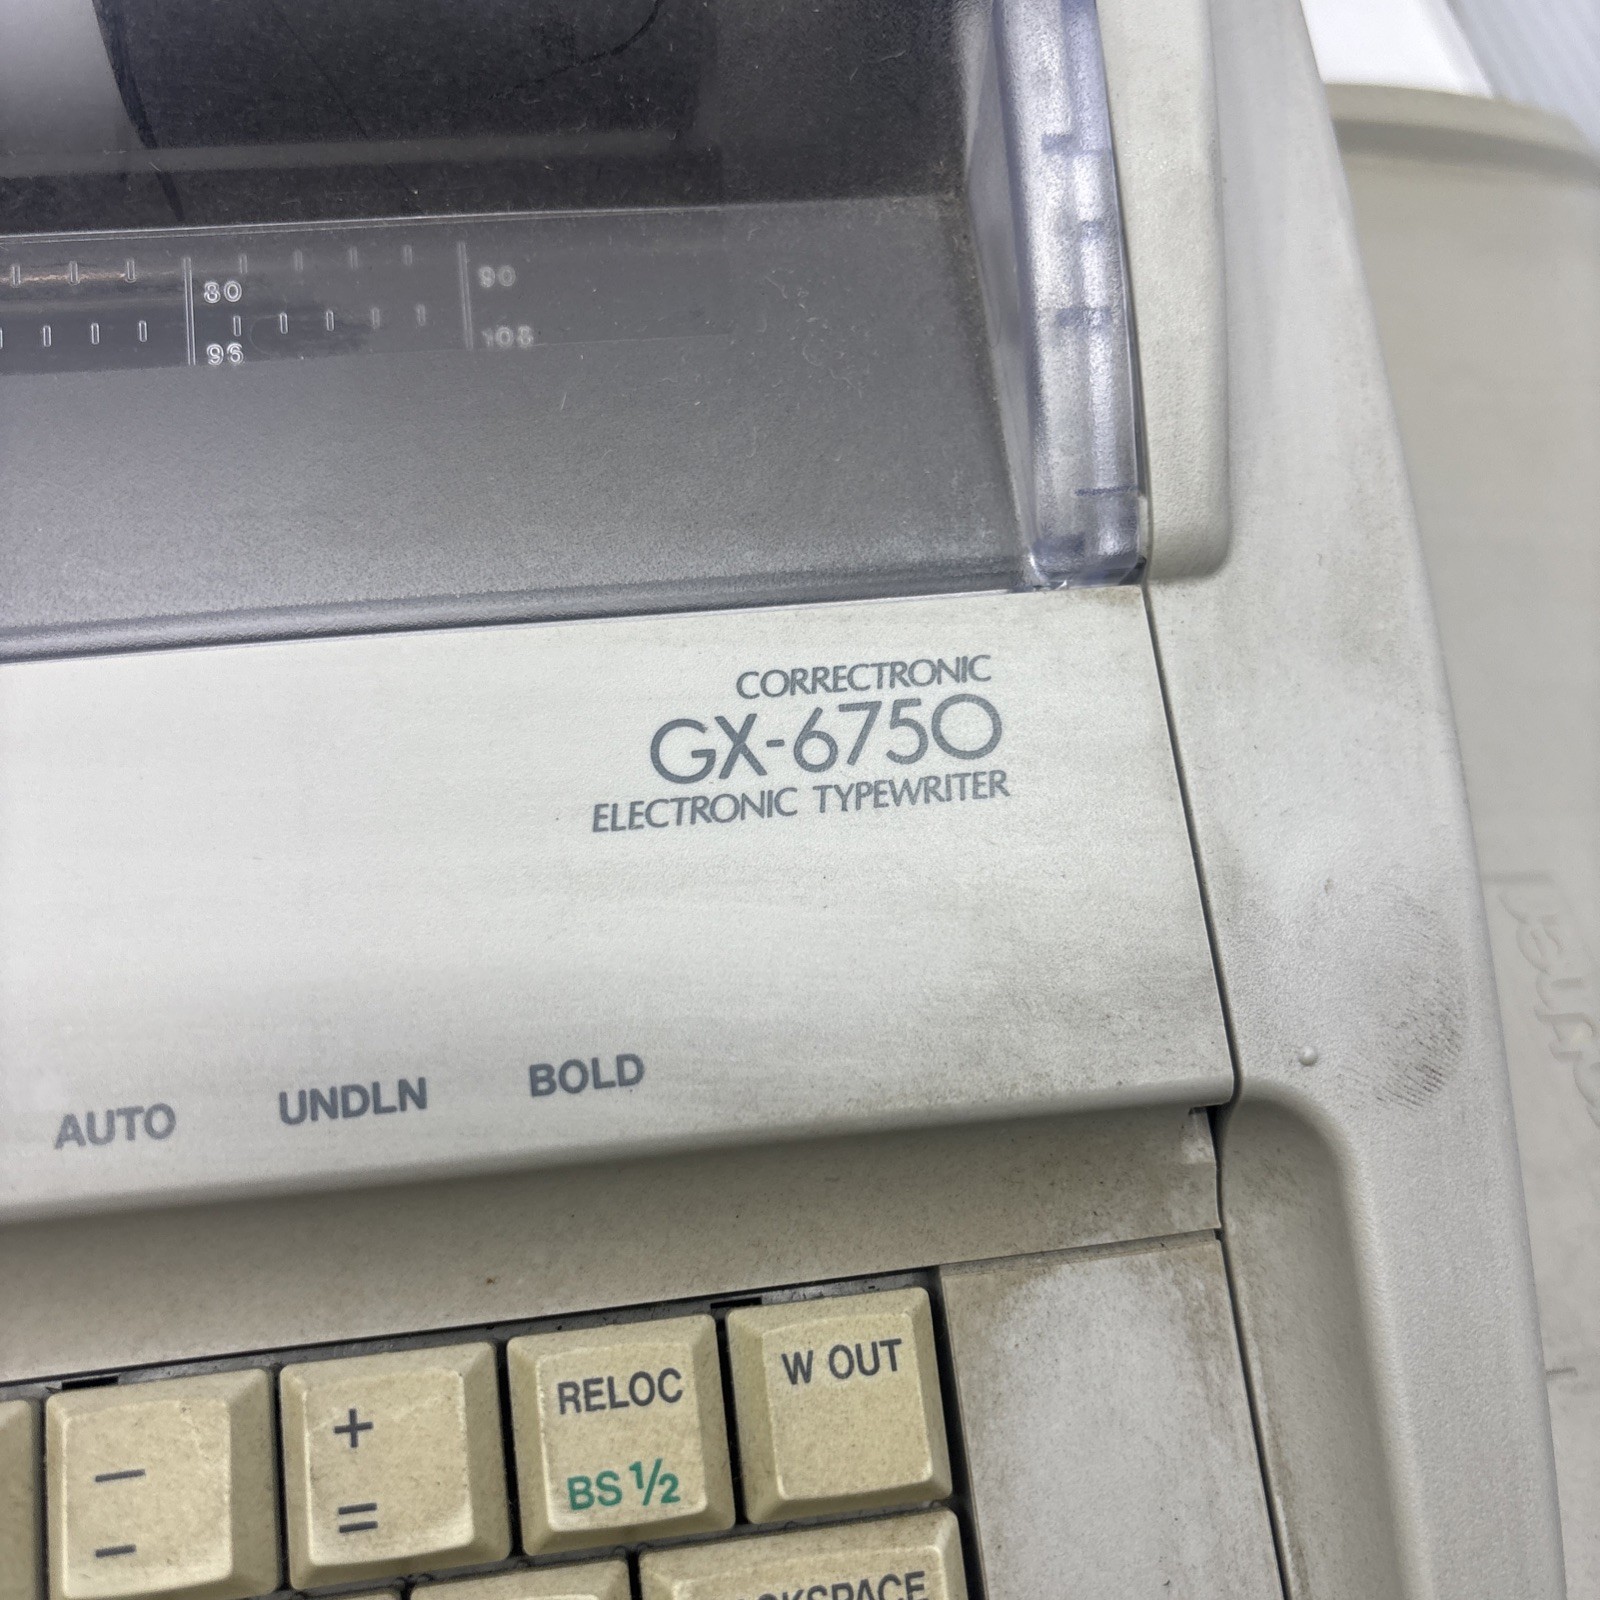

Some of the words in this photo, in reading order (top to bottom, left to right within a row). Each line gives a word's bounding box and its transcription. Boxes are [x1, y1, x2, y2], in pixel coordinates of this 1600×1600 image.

[203, 280, 243, 304] 80
[736, 654, 992, 699] CORRECTRONIC
[650, 693, 1002, 785] GX-6750
[592, 787, 798, 833] ELECTRONIC
[813, 769, 1011, 814] TYPEWRITER
[530, 1053, 646, 1098] BOLD
[278, 1077, 428, 1126] UNDLN
[54, 1102, 177, 1150] AUTO
[782, 1350, 814, 1386] W
[828, 1338, 903, 1381] OUT
[557, 1367, 684, 1415] RELOC
[567, 1470, 623, 1511] BS
